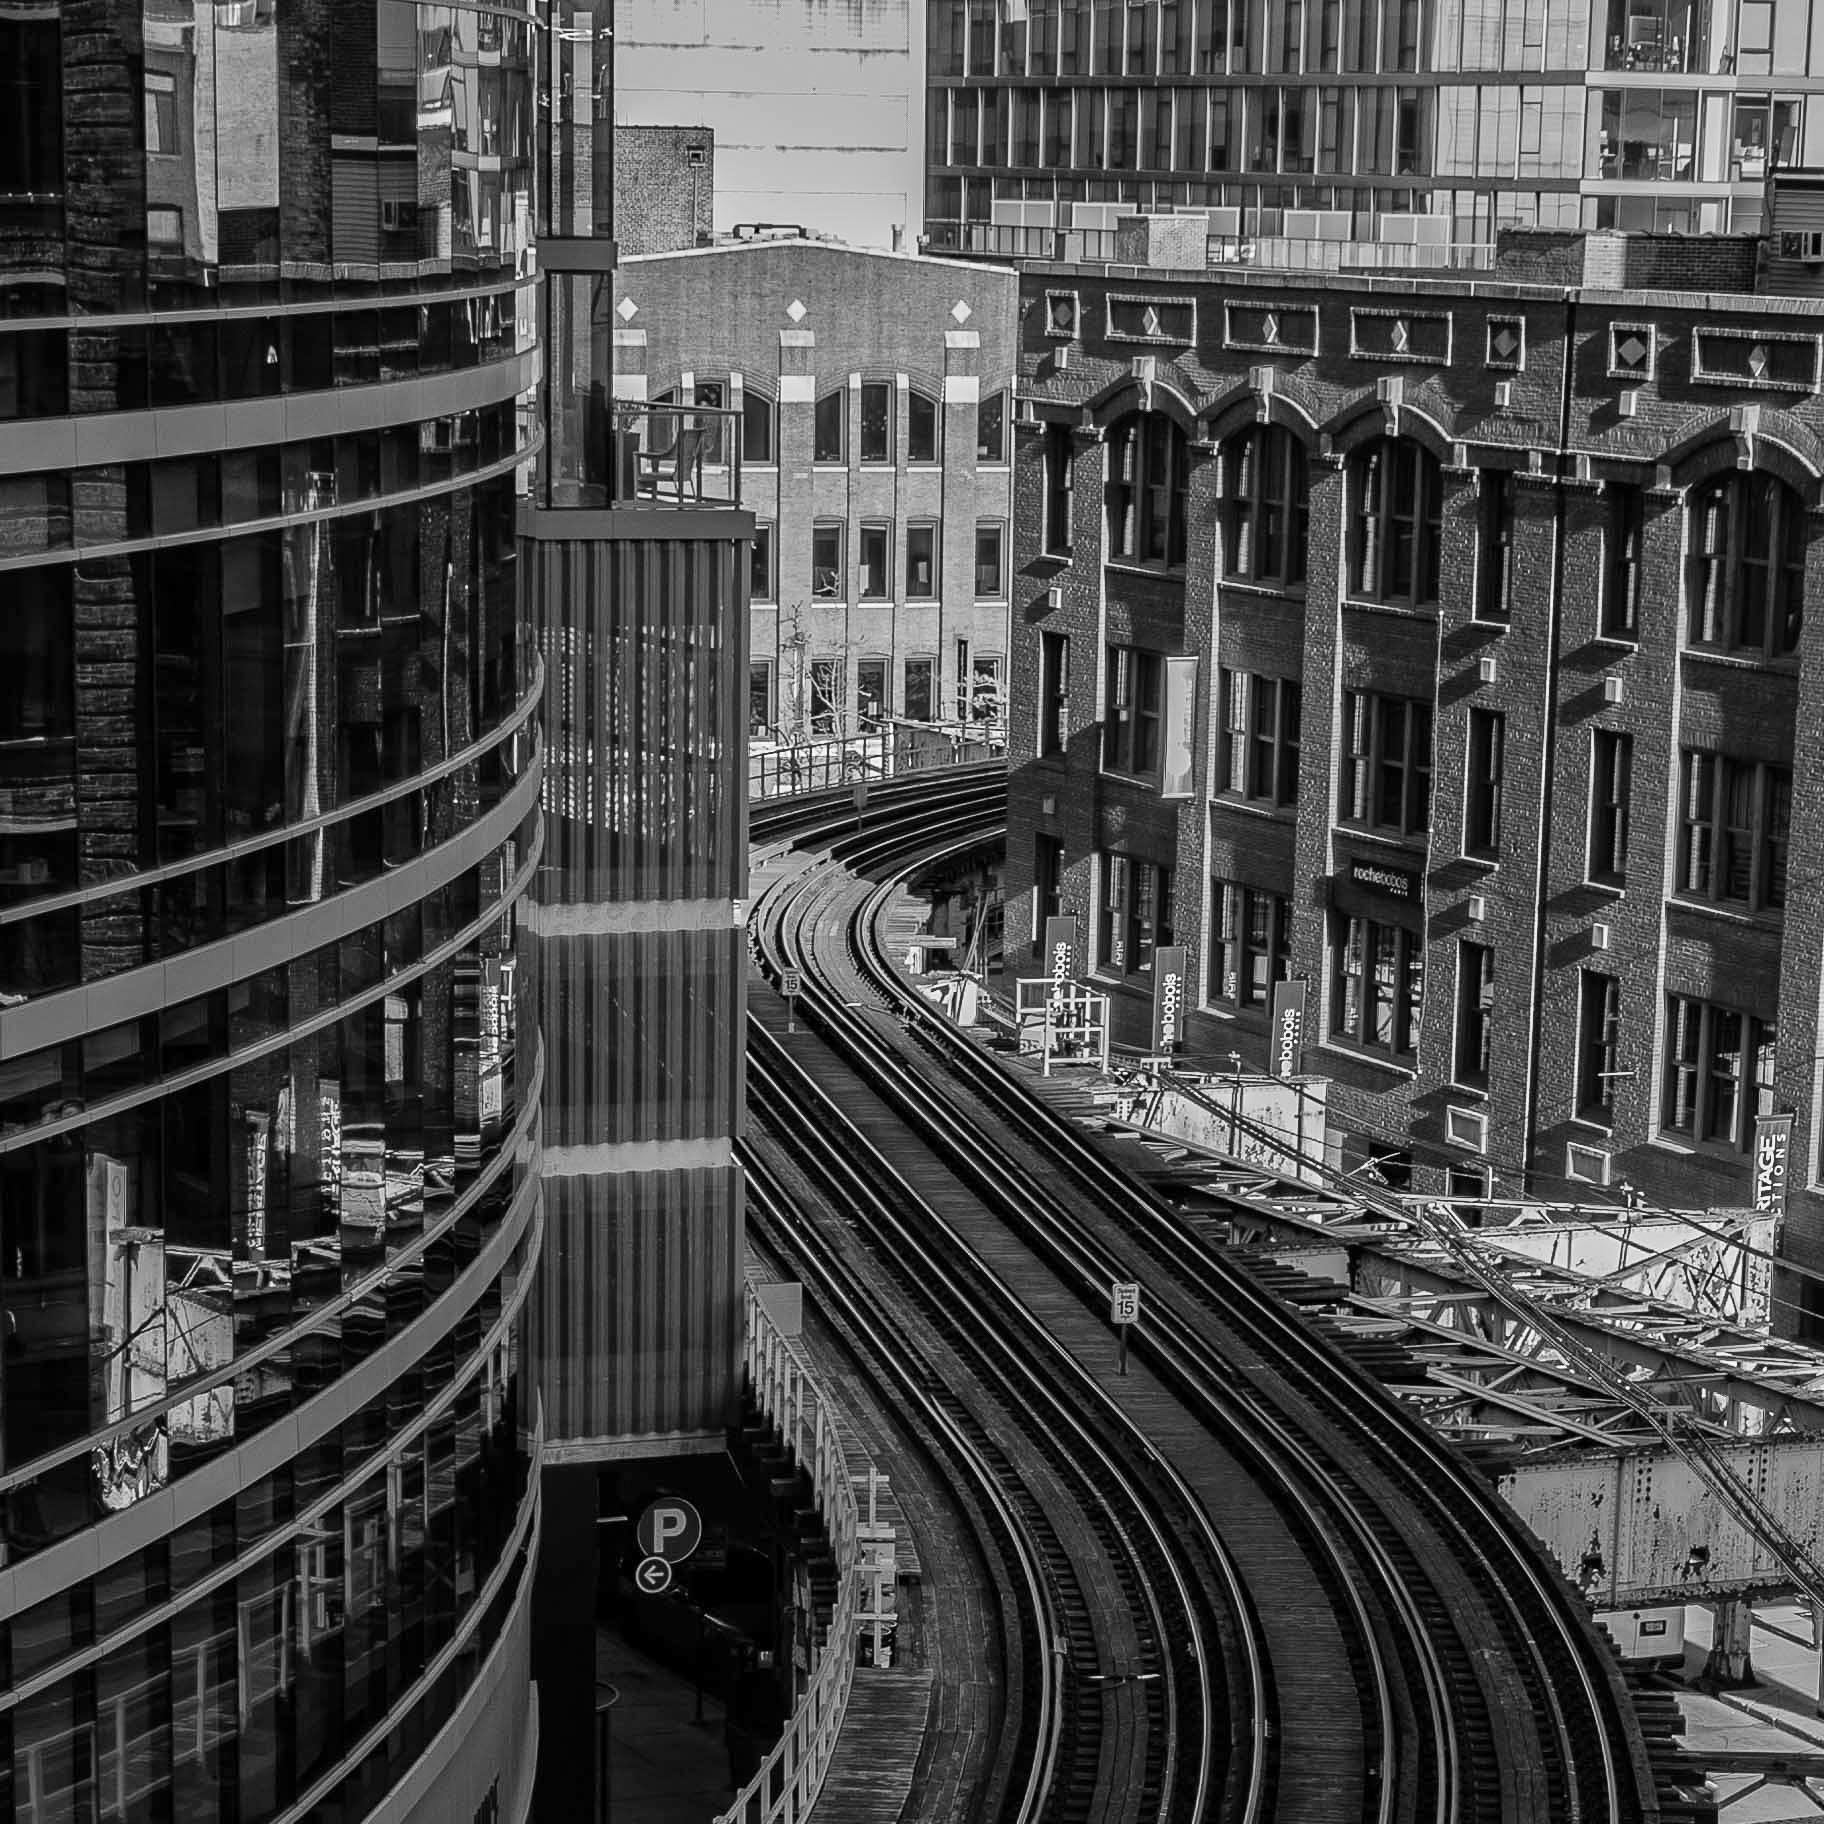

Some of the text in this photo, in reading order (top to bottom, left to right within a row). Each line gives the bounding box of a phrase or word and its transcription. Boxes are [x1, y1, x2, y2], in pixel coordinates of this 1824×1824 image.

[1755, 1134, 1776, 1212] RITAGE
[1117, 1300, 1135, 1315] 15
[654, 1508, 687, 1553] P
